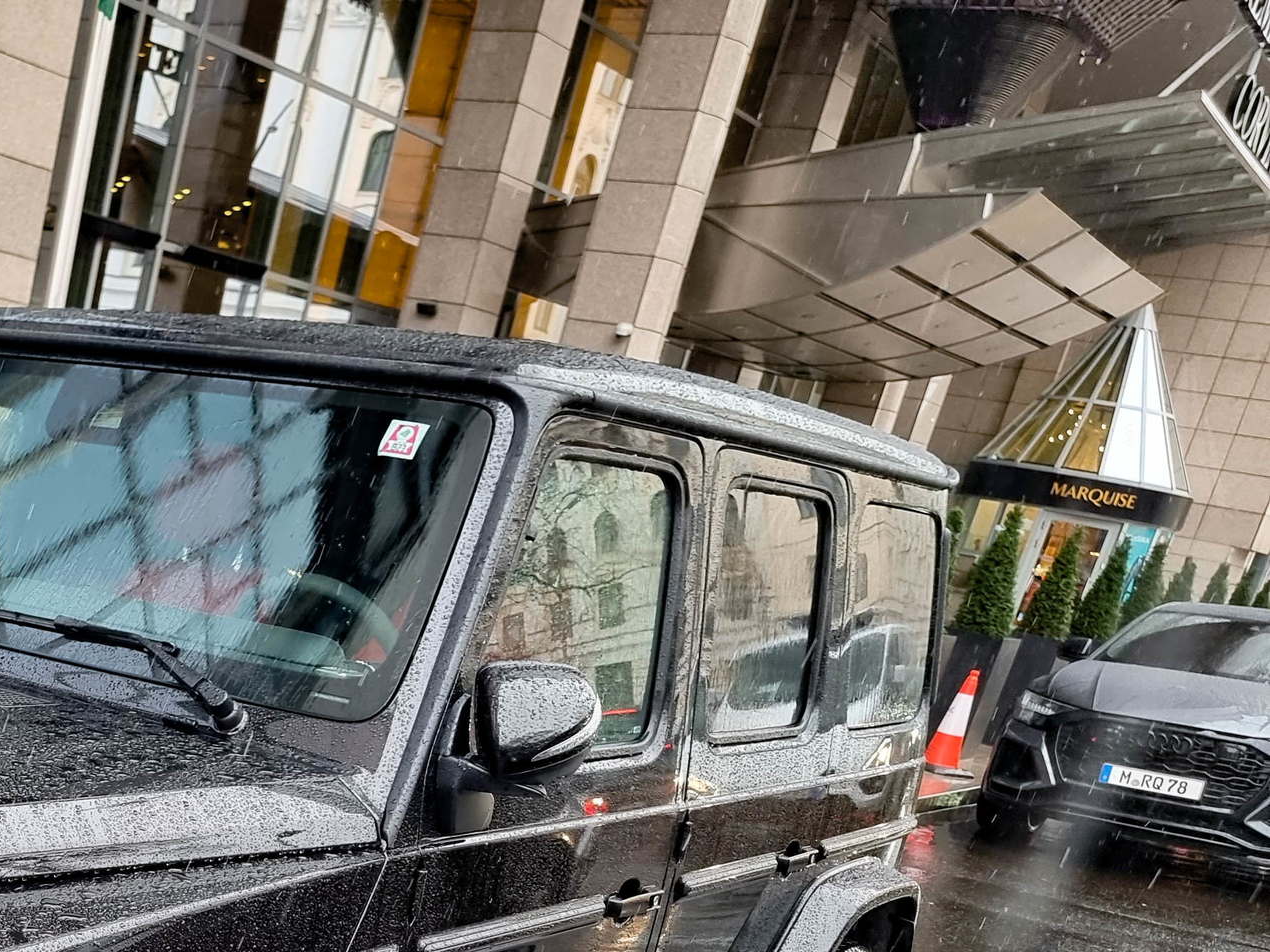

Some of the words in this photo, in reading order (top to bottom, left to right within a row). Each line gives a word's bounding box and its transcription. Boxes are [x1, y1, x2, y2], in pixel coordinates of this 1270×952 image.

[1051, 482, 1138, 509] MARQUISE
[1119, 770, 1132, 784] M
[1141, 774, 1164, 790] RQ
[1167, 779, 1188, 795] 78
